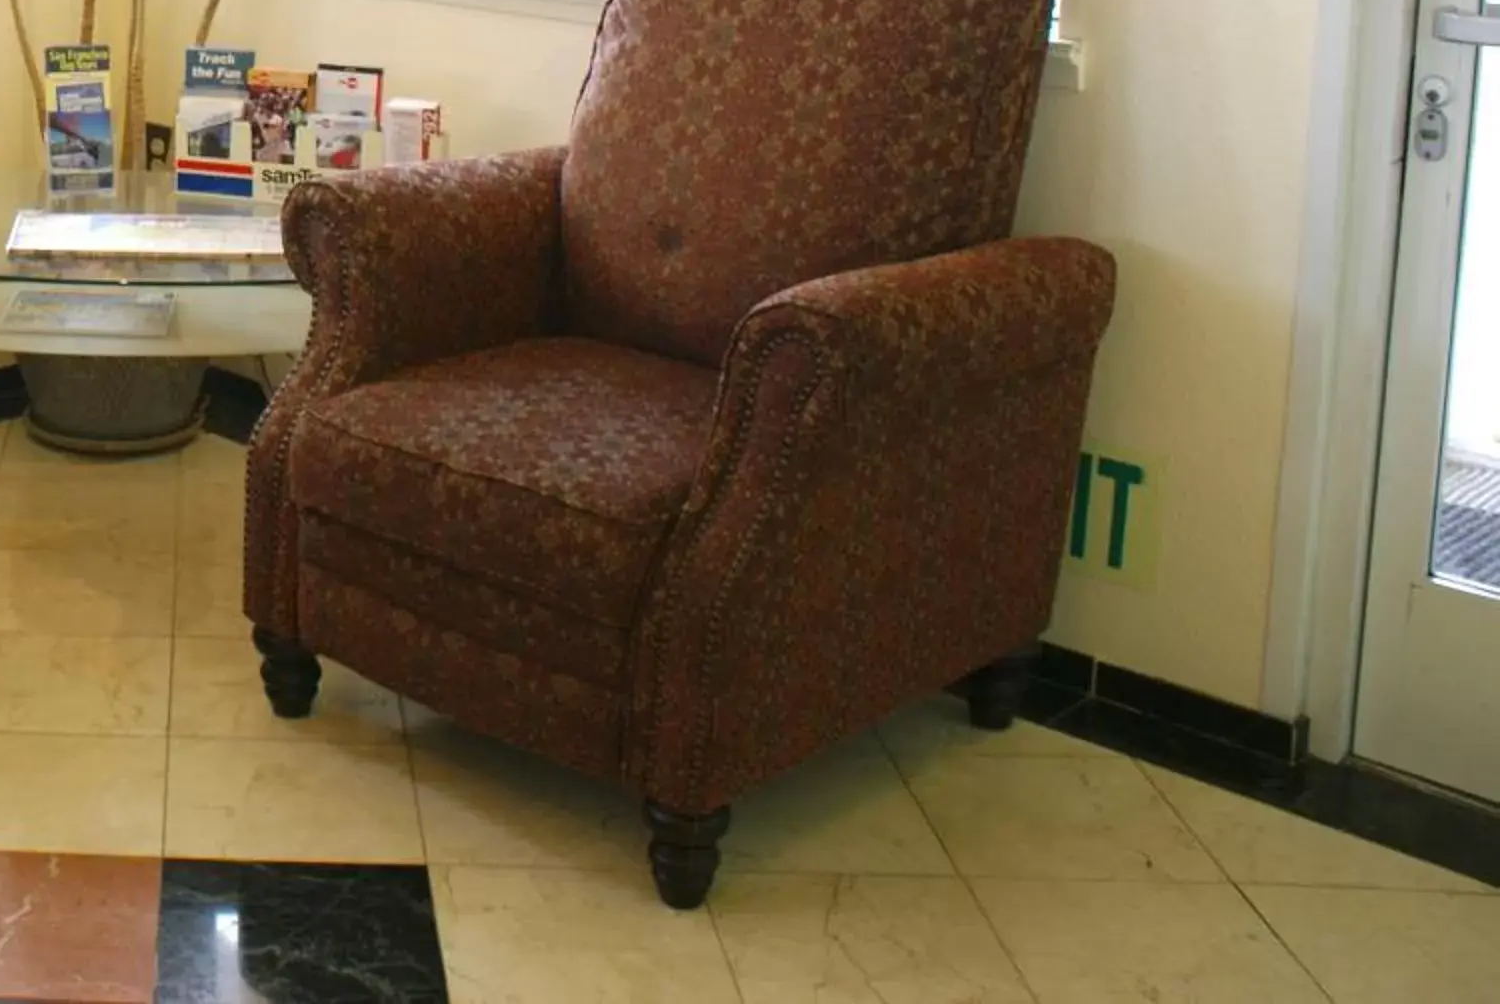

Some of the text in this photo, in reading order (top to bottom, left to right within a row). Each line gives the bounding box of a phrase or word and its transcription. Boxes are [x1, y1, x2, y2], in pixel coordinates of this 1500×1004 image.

[199, 52, 235, 65] Track
[191, 66, 242, 79] the Fun
